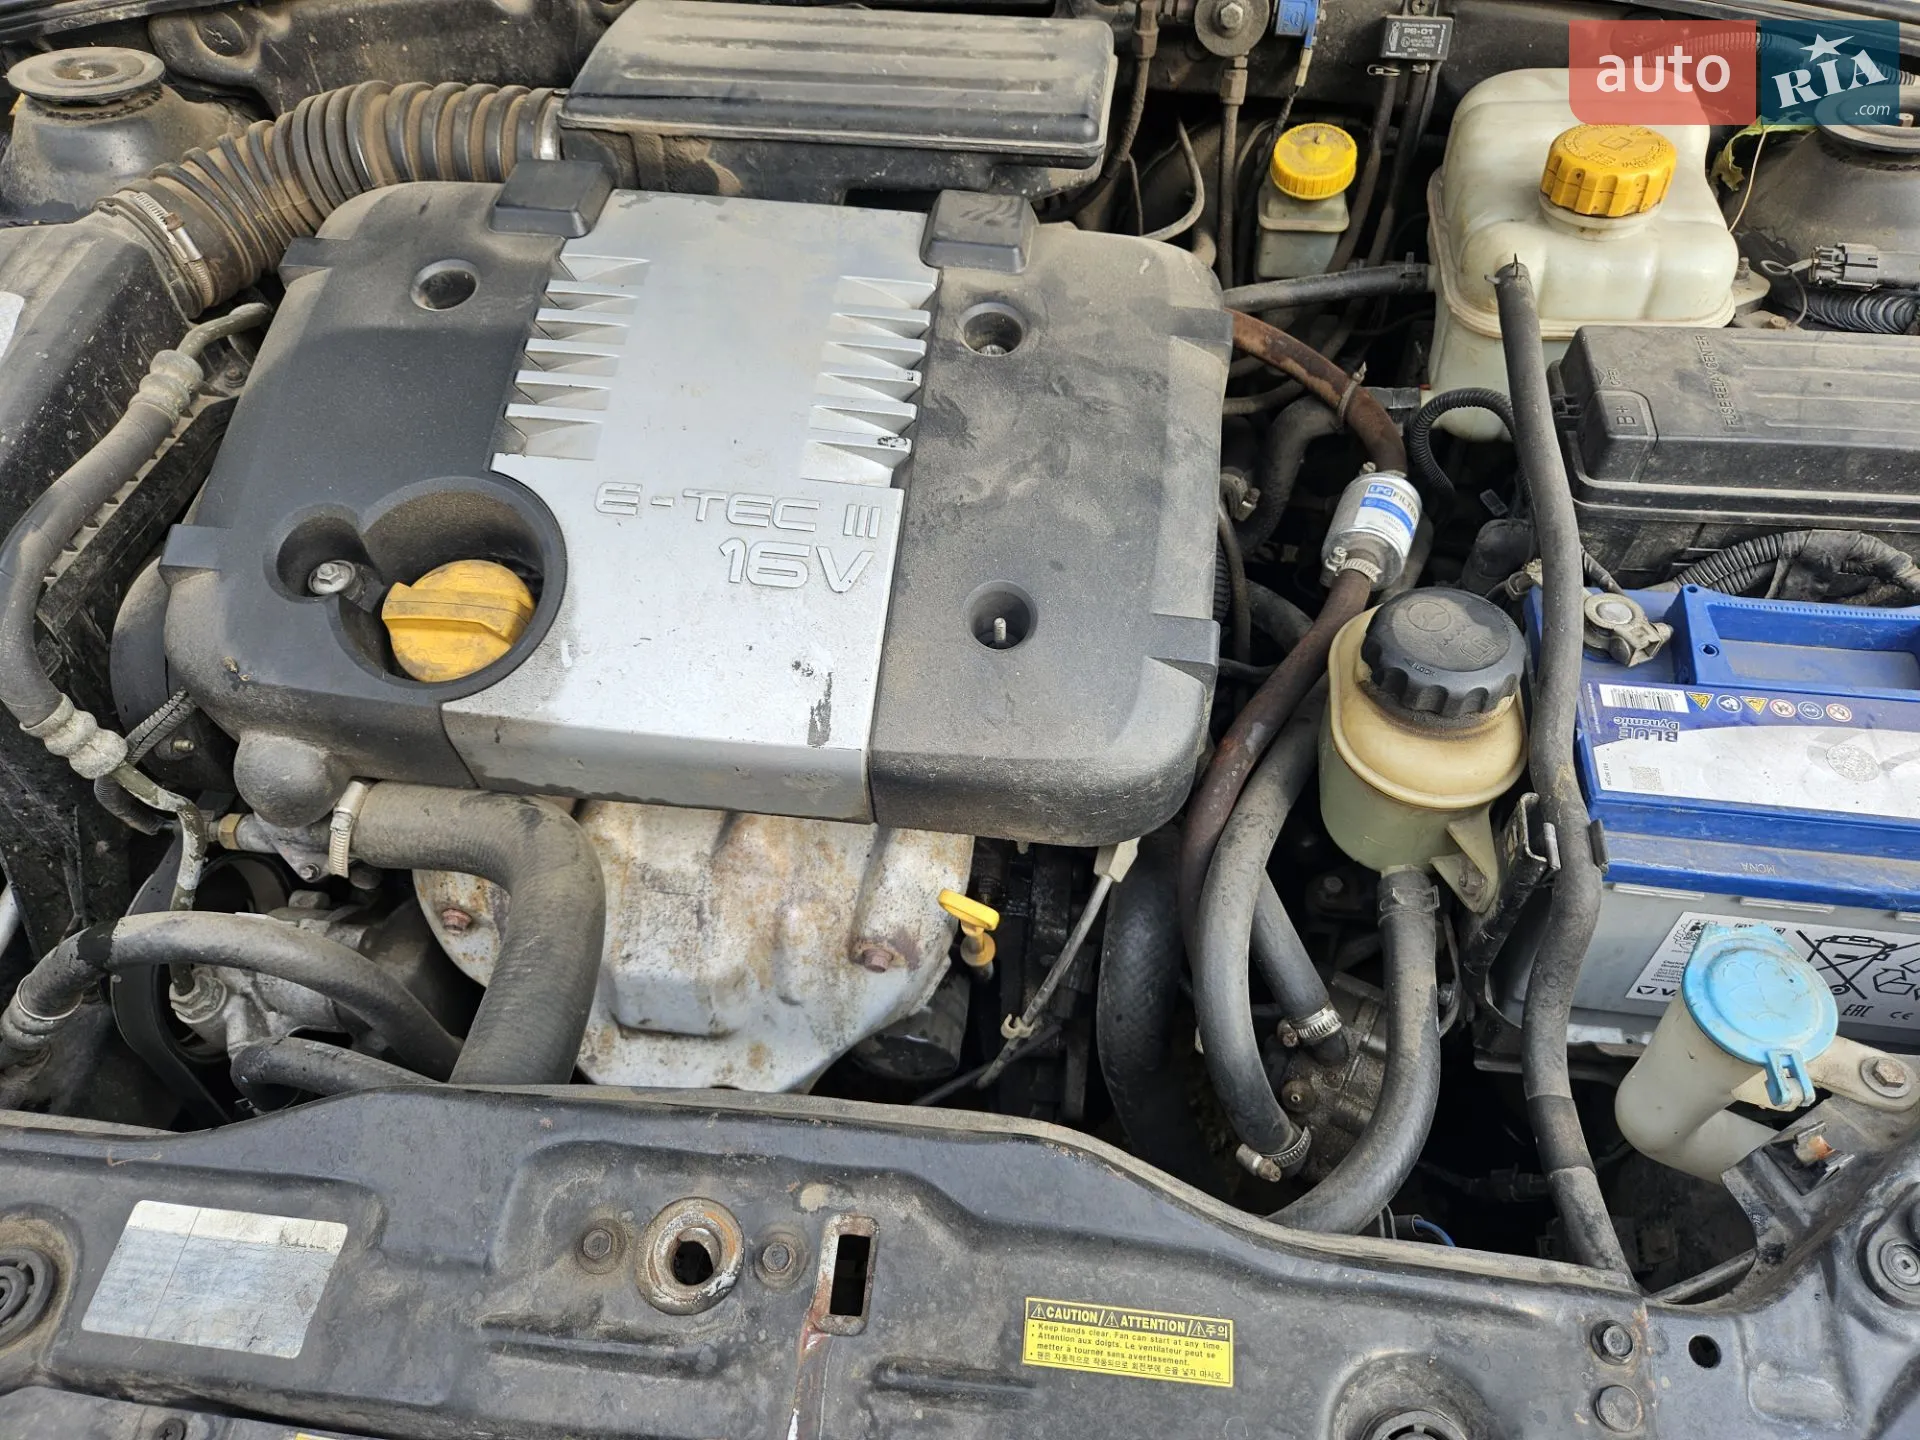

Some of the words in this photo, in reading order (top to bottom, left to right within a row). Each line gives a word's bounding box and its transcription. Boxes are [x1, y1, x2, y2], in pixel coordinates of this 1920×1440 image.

[1369, 486, 1393, 497] LPG
[595, 481, 820, 532] E-TEC
[843, 503, 881, 538] III
[718, 537, 874, 593] 16V
[1613, 717, 1680, 731] Dynamic
[1618, 726, 1679, 742] BLUE
[1038, 1323, 1058, 1332] Keep
[1061, 1326, 1085, 1335] hands
[1089, 1329, 1111, 1338] clear.
[1115, 1331, 1128, 1340] Fan
[1151, 1336, 1170, 1344] start
[1173, 1338, 1181, 1346] at
[1185, 1341, 1199, 1349] any
[1203, 1342, 1223, 1351] time.
[1206, 1324, 1228, 1339] 주의
[1038, 1333, 1075, 1343] Attention
[1078, 1337, 1092, 1345] aux
[1095, 1338, 1122, 1348] doigts.
[1125, 1342, 1135, 1350] Le
[1139, 1345, 1182, 1355] ventilateur
[1185, 1348, 1203, 1358] peut
[1074, 1347, 1104, 1356] tourner
[1107, 1350, 1125, 1359] sans
[1128, 1353, 1190, 1366] avertissement.
